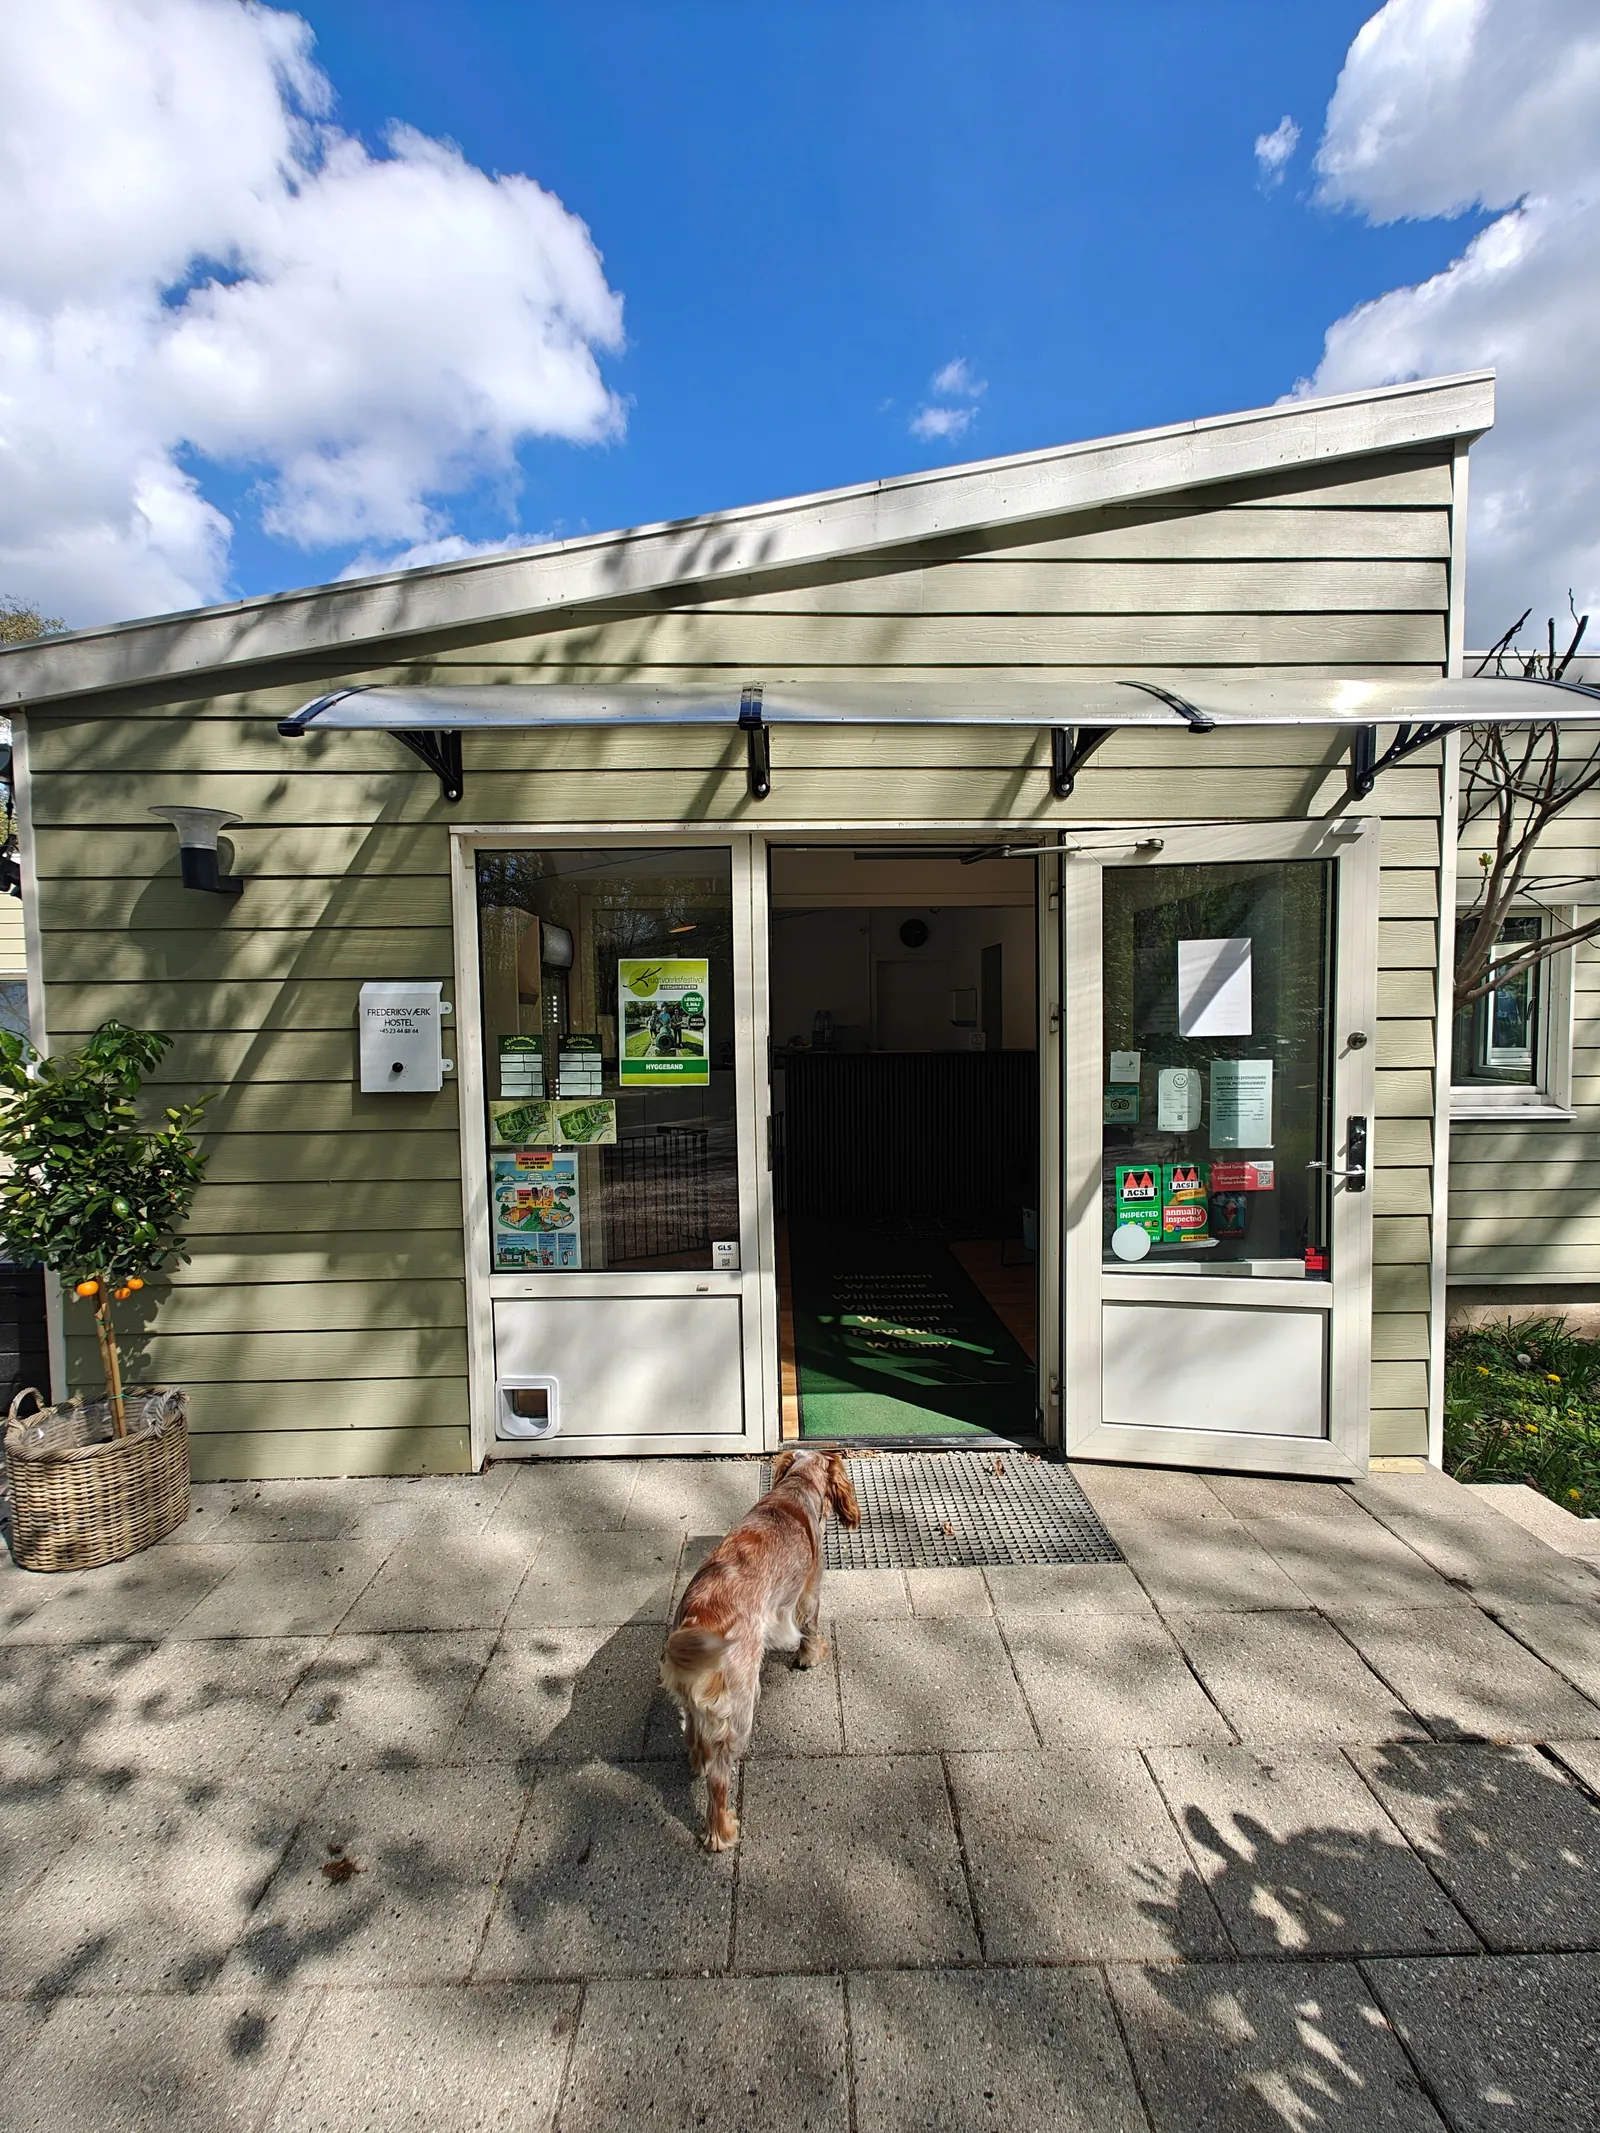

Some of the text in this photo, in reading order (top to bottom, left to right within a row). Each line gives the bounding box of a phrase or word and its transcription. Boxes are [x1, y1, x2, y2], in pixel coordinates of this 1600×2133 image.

[367, 1008, 431, 1016] FREDERIKSVÆRK
[1166, 1215, 1202, 1224] inspected
[831, 1292, 949, 1300] Willkommen
[841, 1303, 956, 1311] Välkommen
[857, 1314, 940, 1323] Welkom
[848, 1327, 959, 1336] Tervetuloa
[865, 1340, 952, 1349] Witamy
